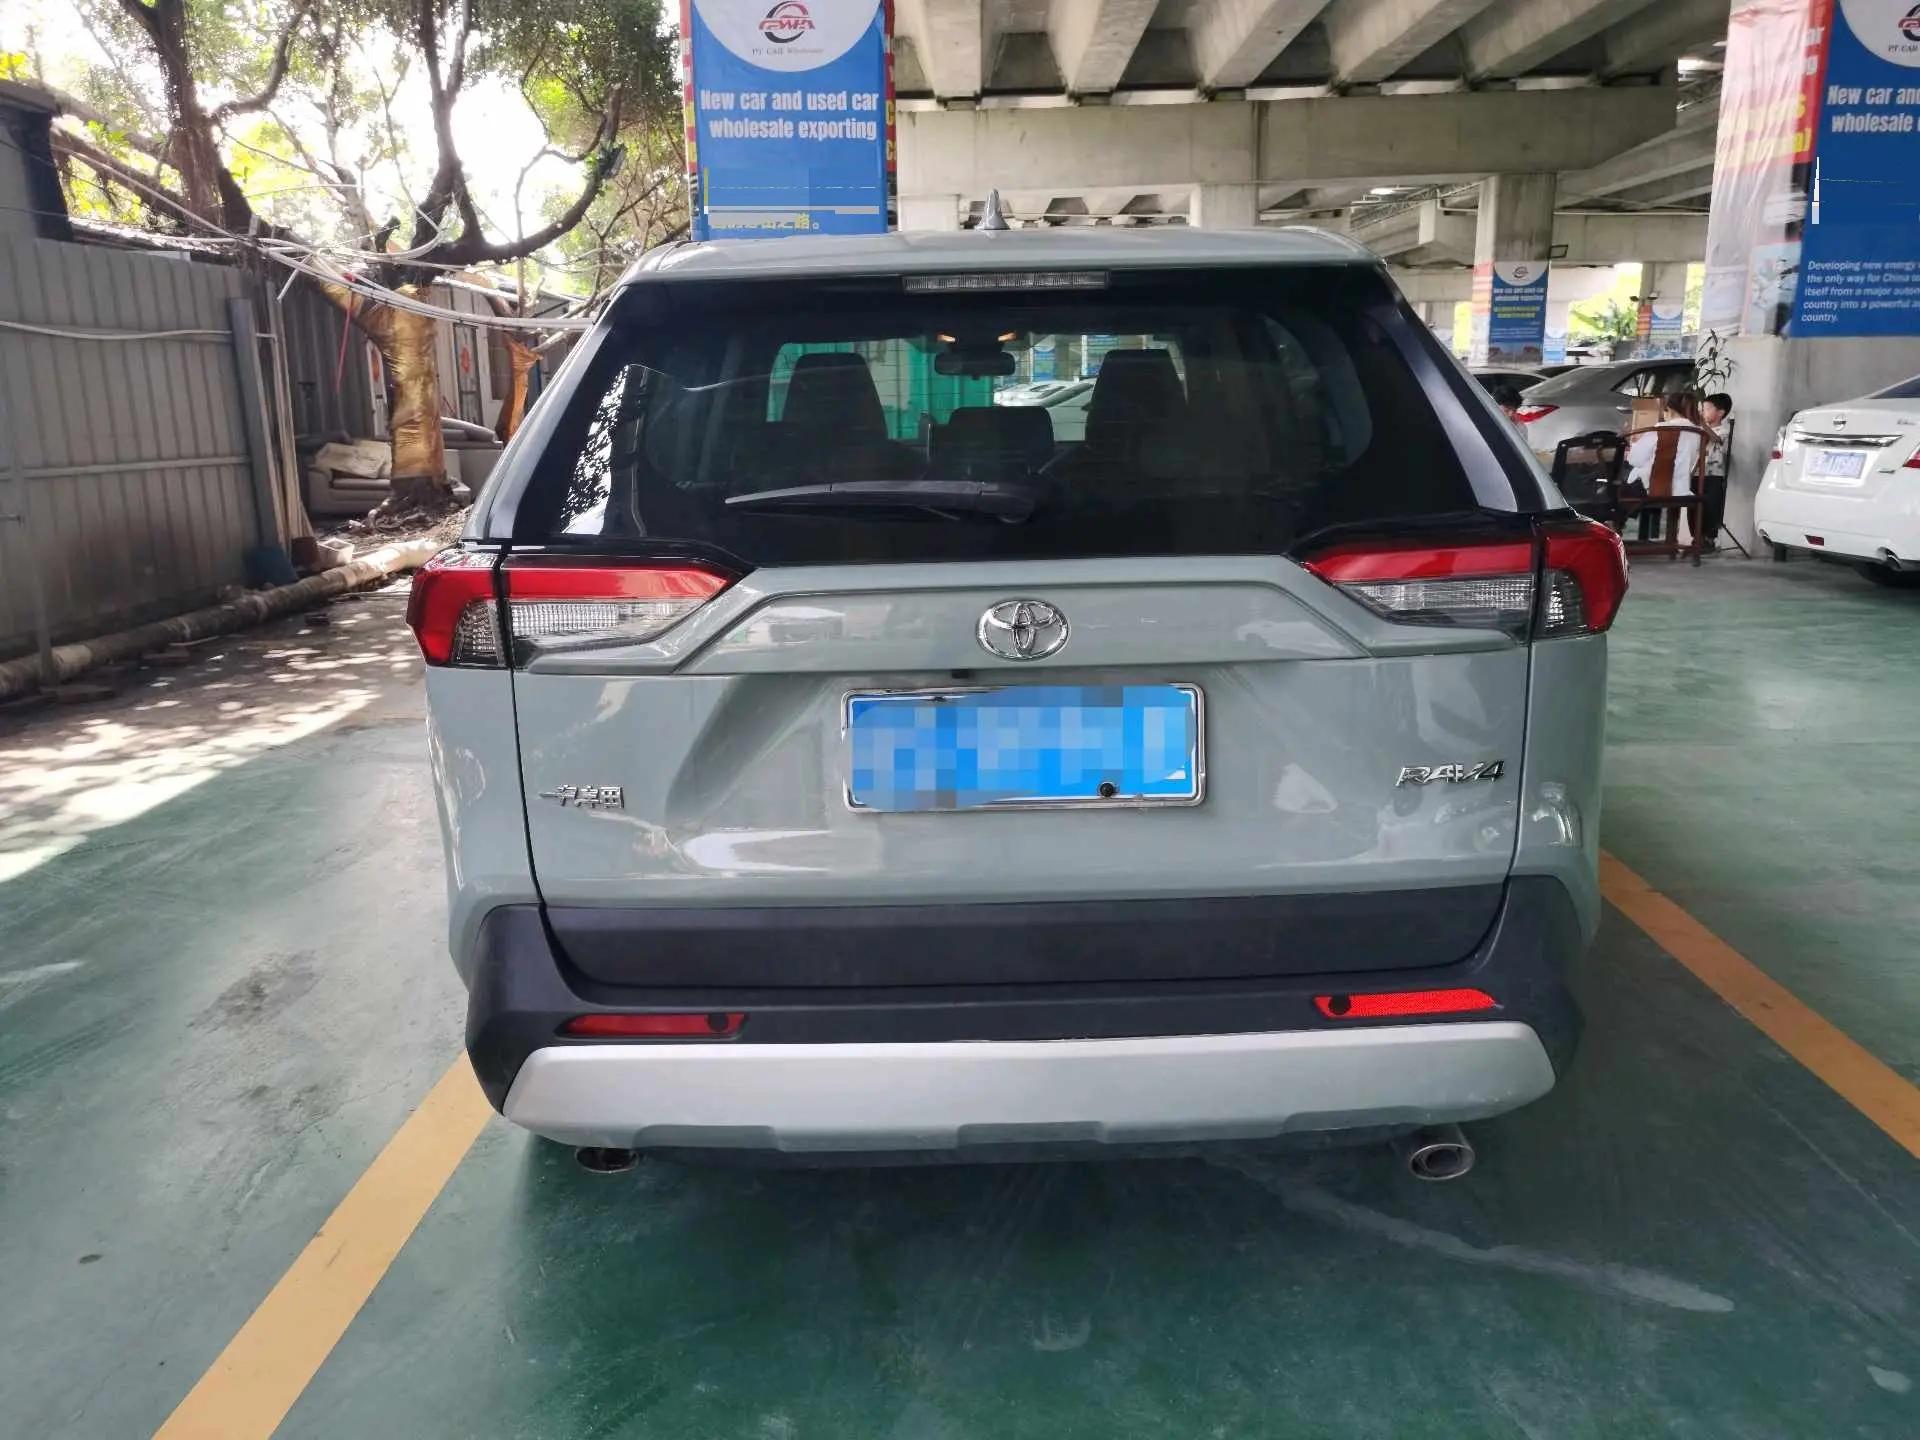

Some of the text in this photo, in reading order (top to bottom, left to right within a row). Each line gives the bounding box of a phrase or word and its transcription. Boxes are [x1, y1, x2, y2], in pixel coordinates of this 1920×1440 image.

[701, 90, 879, 111] New car and used car
[1827, 85, 1862, 105] New
[1865, 87, 1893, 105] car
[709, 118, 877, 141] wholesale exporting
[1831, 112, 1914, 133] wholesale
[1807, 260, 1915, 271] Developing new energy
[1807, 273, 1823, 283] the
[1825, 272, 1845, 284] only
[1846, 275, 1865, 284] way
[1866, 273, 1880, 282] for
[1882, 273, 1909, 282] China
[1830, 286, 1853, 296] from
[1863, 286, 1892, 297] major
[1803, 300, 1838, 311] country
[1840, 300, 1859, 309] into
[1860, 301, 1867, 309] a
[1868, 300, 1910, 311] powerful
[1801, 313, 1838, 324] country.
[1394, 760, 1504, 787] RAV4
